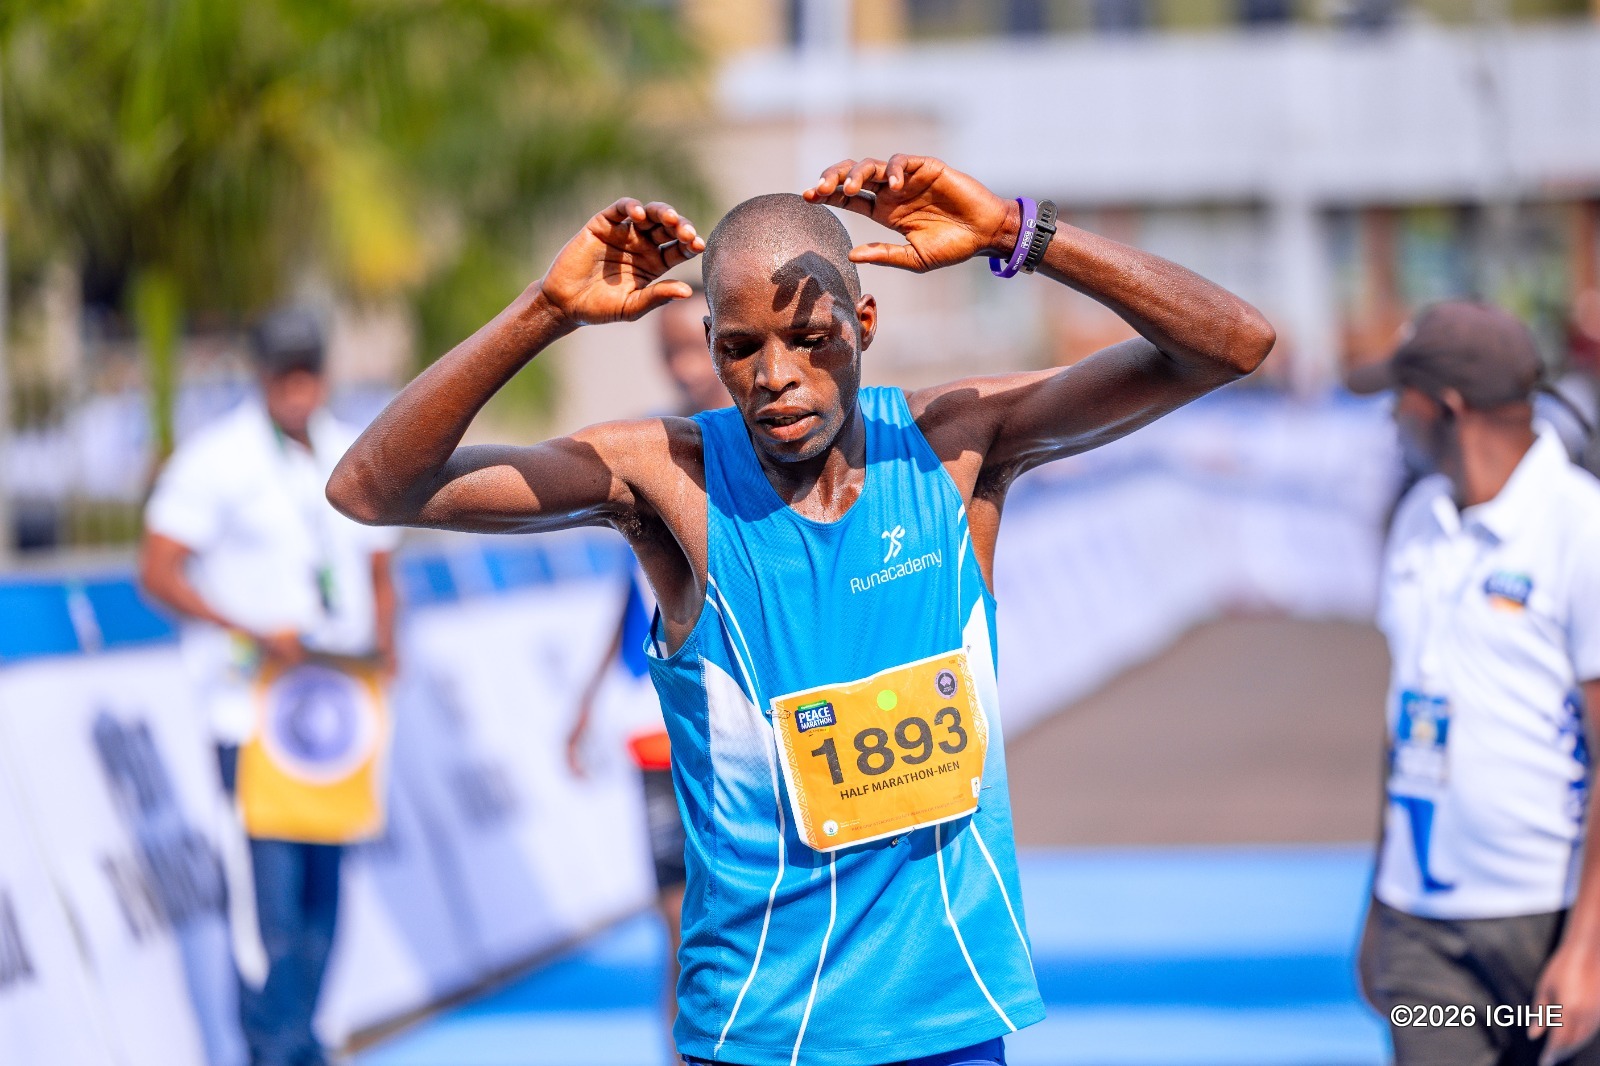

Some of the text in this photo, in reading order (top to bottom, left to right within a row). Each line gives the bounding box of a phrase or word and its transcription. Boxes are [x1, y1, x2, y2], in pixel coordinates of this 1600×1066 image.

[850, 549, 942, 594] Runacademy
[798, 706, 831, 724] PEACE
[800, 716, 833, 730] MARATHON
[811, 706, 968, 786] 1893
[840, 761, 960, 800] HALF MARATHON-MEN
